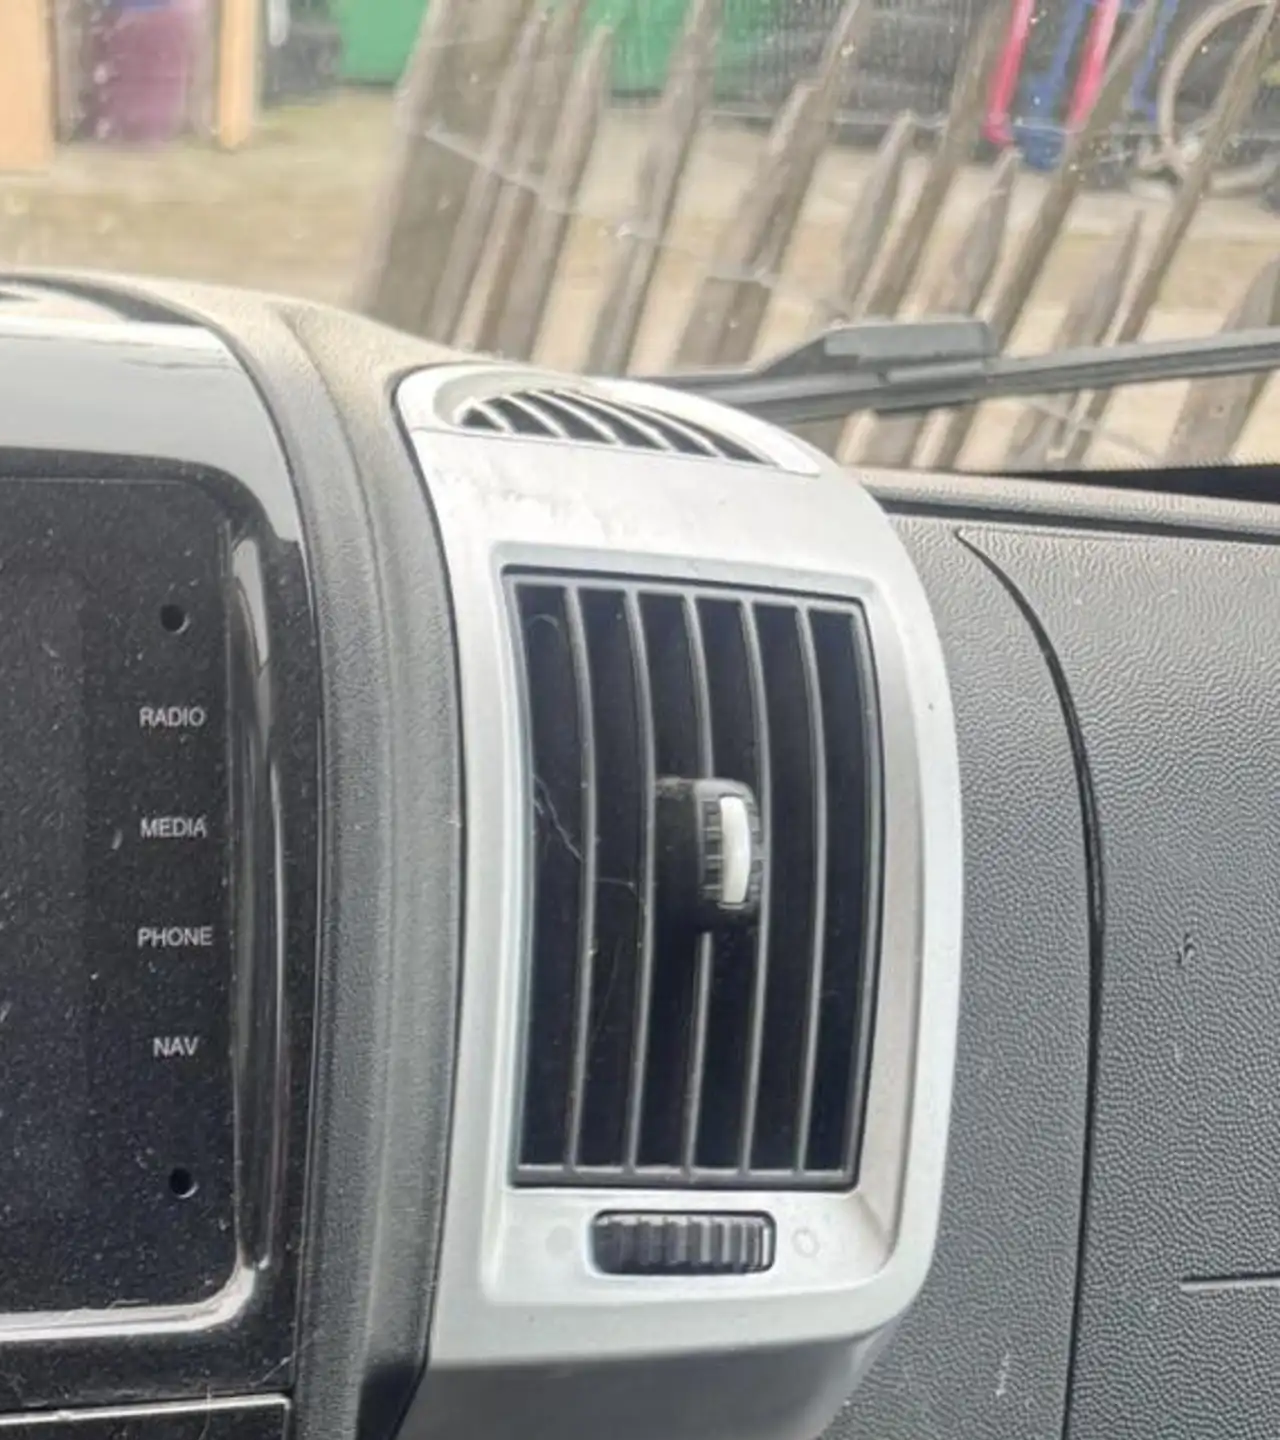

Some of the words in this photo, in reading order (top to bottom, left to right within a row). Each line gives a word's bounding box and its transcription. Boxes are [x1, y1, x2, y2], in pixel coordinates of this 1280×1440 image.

[139, 706, 207, 728] RADIO
[140, 816, 207, 839] MEDIA
[137, 925, 213, 948] PHONE
[152, 1036, 199, 1058] NAV
